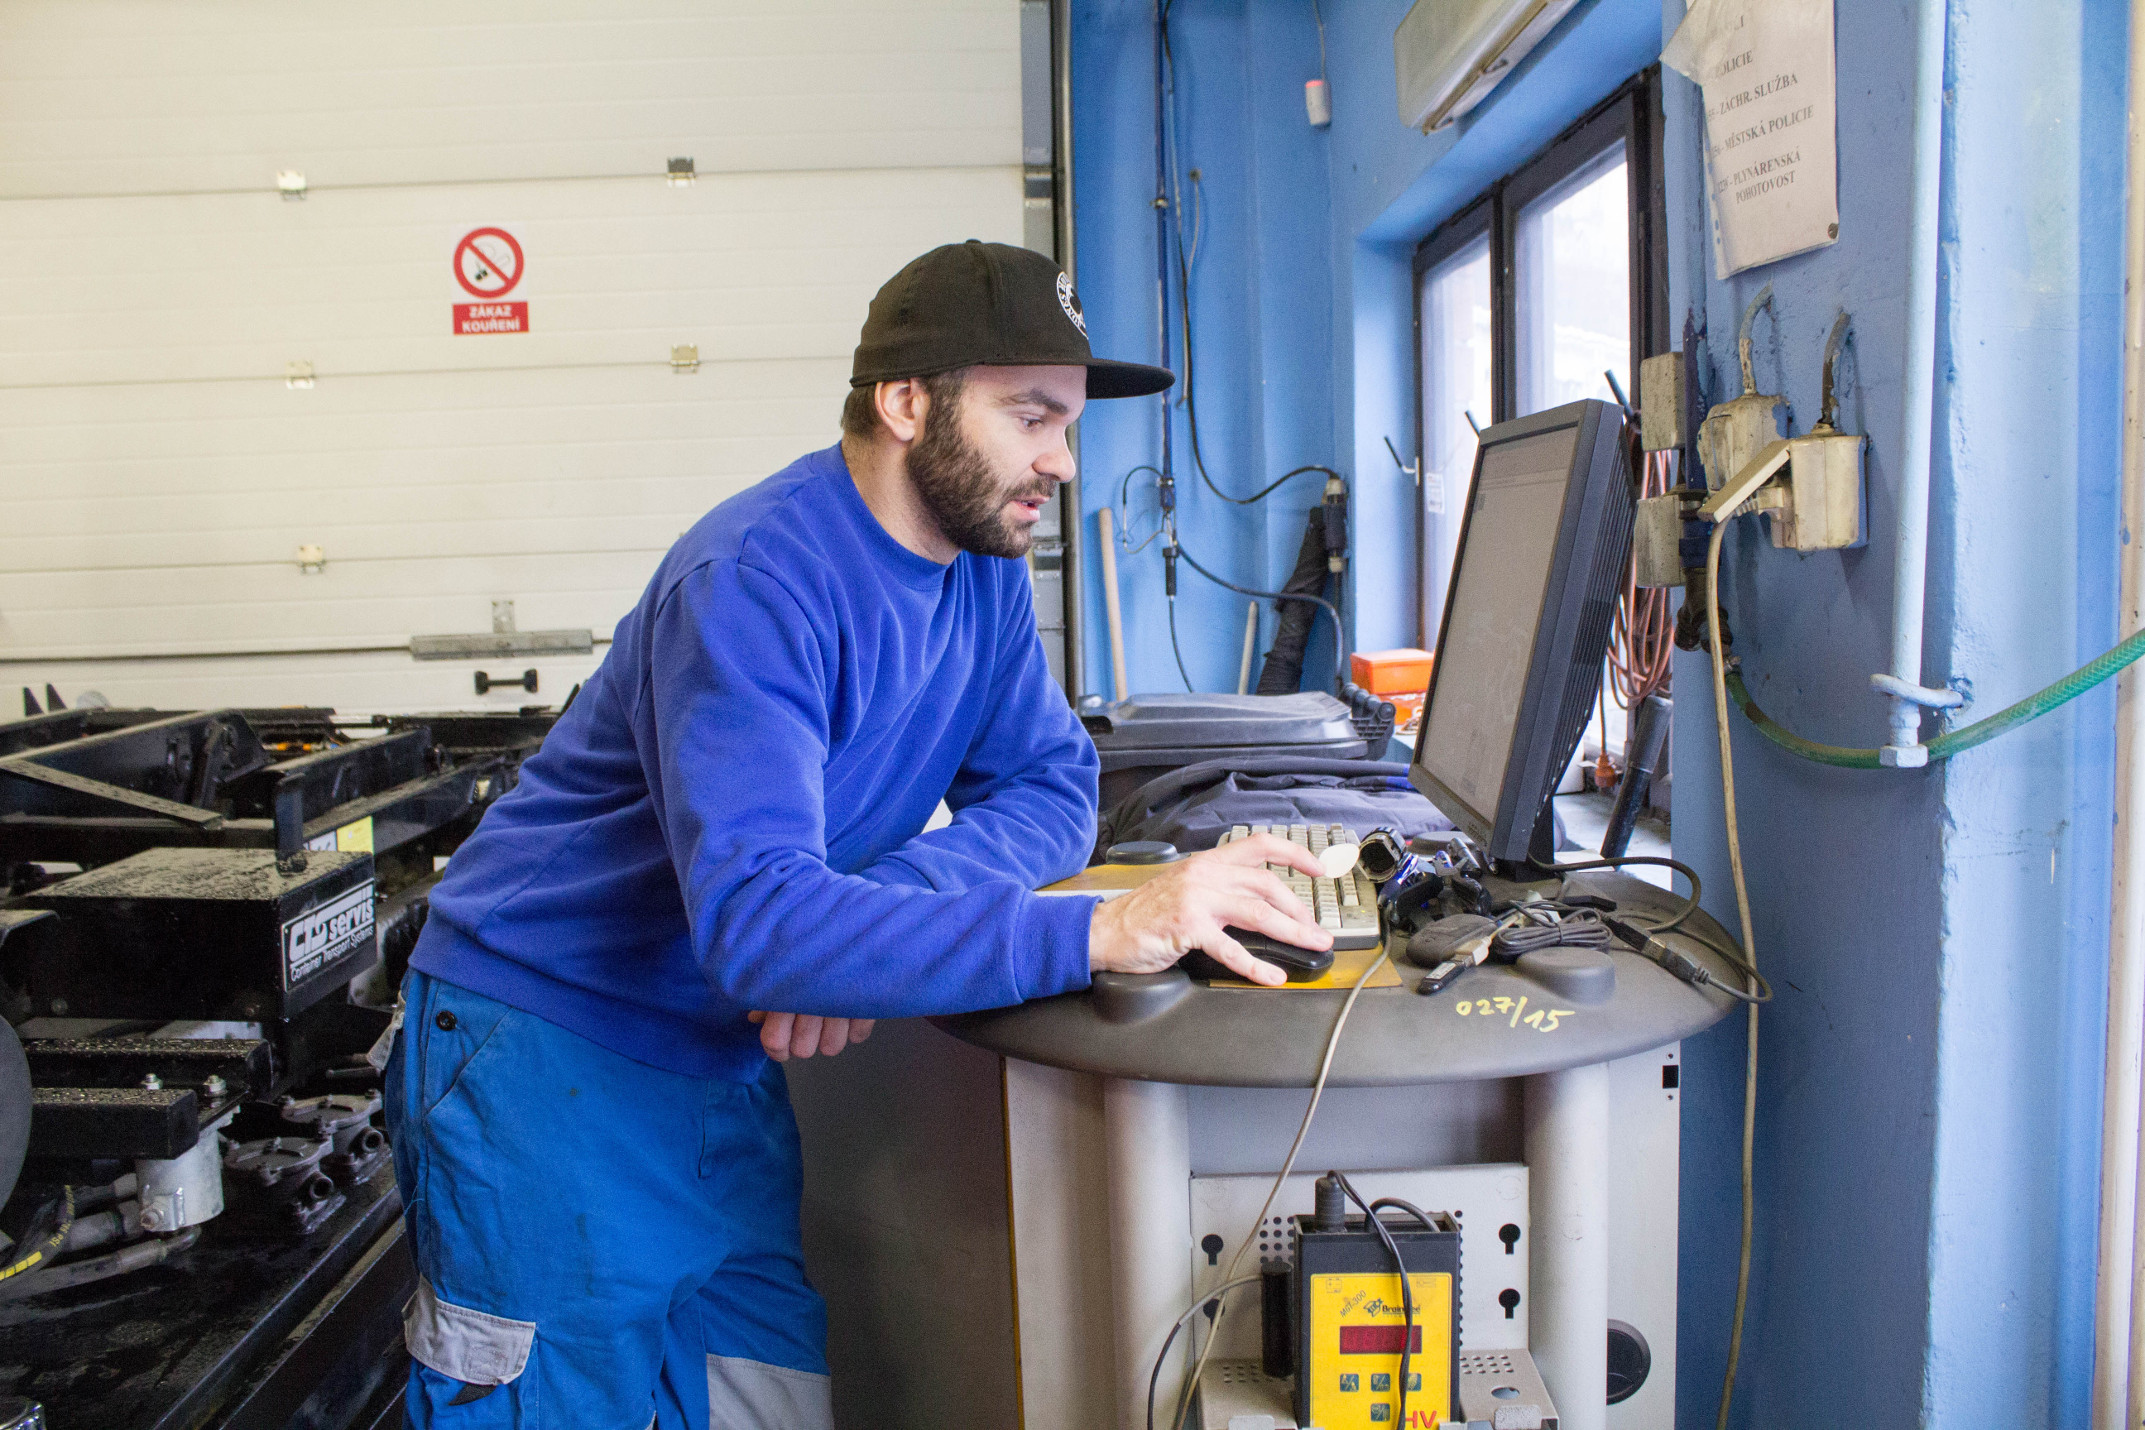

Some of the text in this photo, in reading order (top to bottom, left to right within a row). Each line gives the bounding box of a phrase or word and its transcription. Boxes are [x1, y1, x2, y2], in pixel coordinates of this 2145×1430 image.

[1754, 73, 1798, 100] SLUŽBA
[1769, 105, 1814, 133] POLICIE
[1736, 170, 1796, 204] POHOTOVOST
[462, 315, 520, 333] KOUŘENÍ
[469, 304, 512, 319] ZÁKAZ
[329, 898, 375, 941] servis
[1456, 996, 1576, 1032] 027/15
